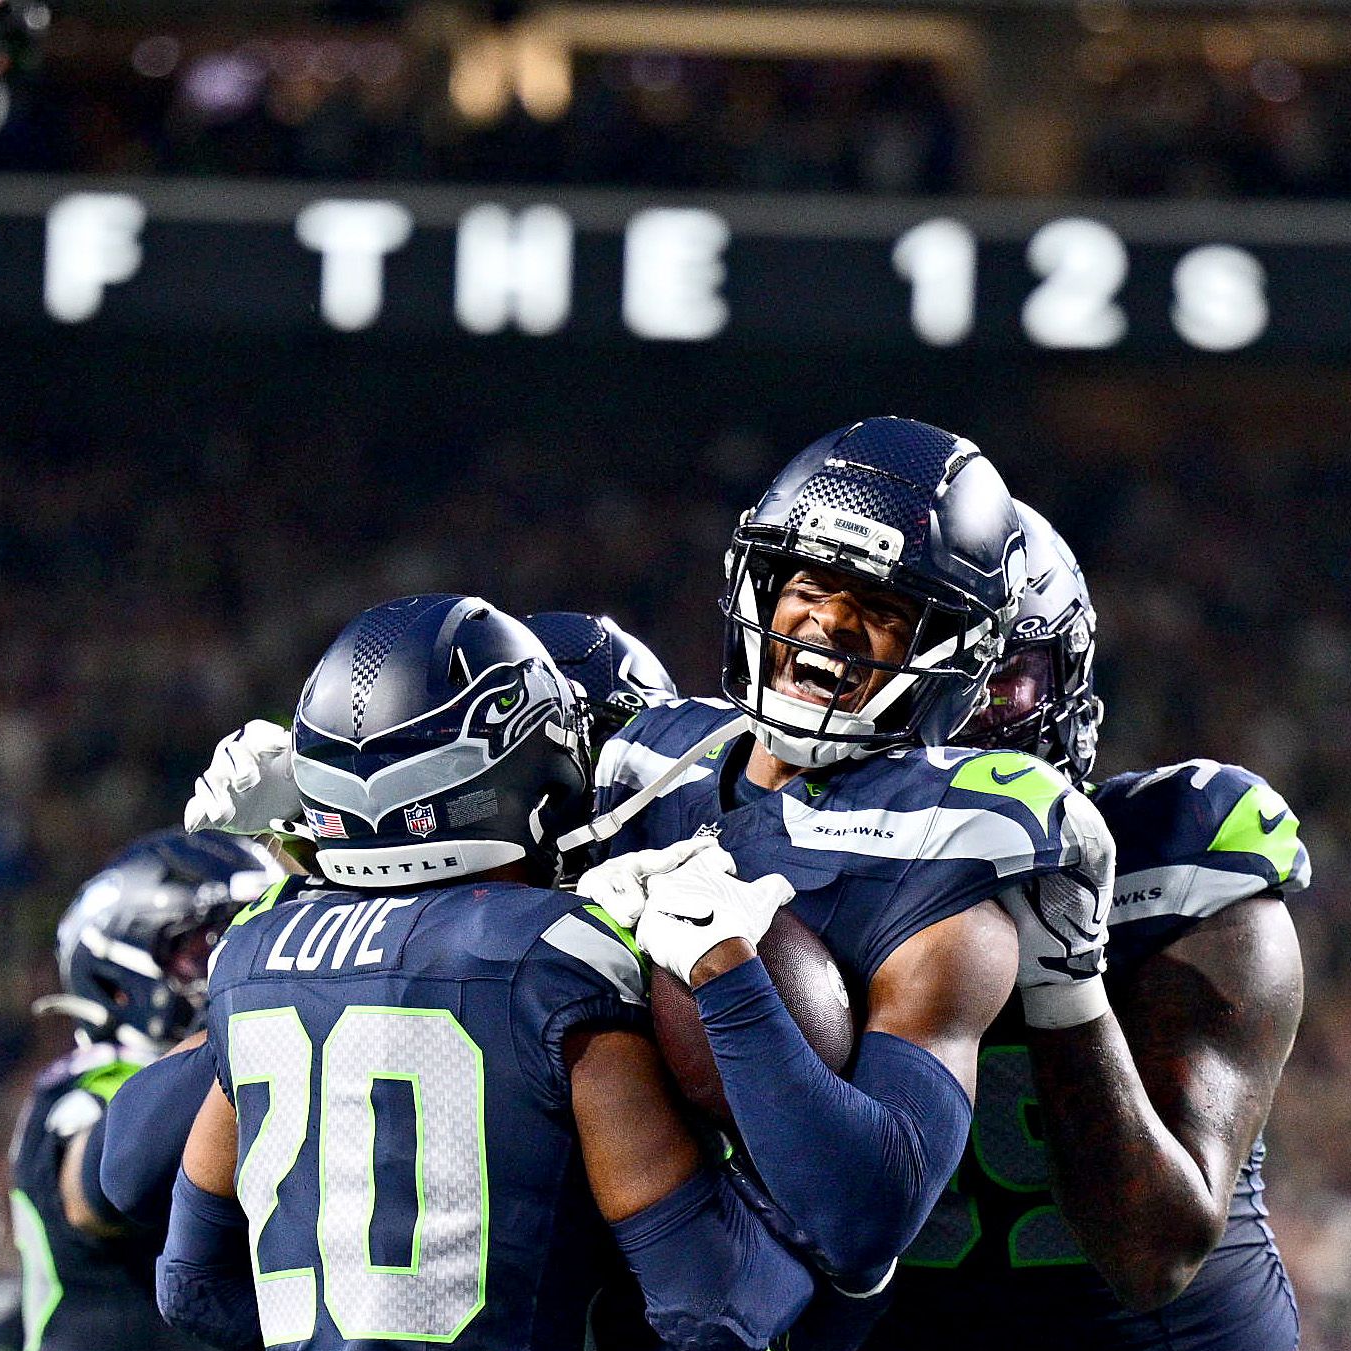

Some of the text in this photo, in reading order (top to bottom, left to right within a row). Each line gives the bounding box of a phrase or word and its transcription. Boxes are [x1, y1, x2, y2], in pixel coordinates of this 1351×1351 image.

[295, 198, 730, 340] THE
[833, 518, 870, 537] SEAHAWKS
[410, 817, 434, 833] NFL
[813, 825, 895, 839] SEAHAWKS
[334, 856, 458, 875] SEATTLE
[265, 897, 419, 971] LOVE
[227, 1005, 490, 1348] 20
